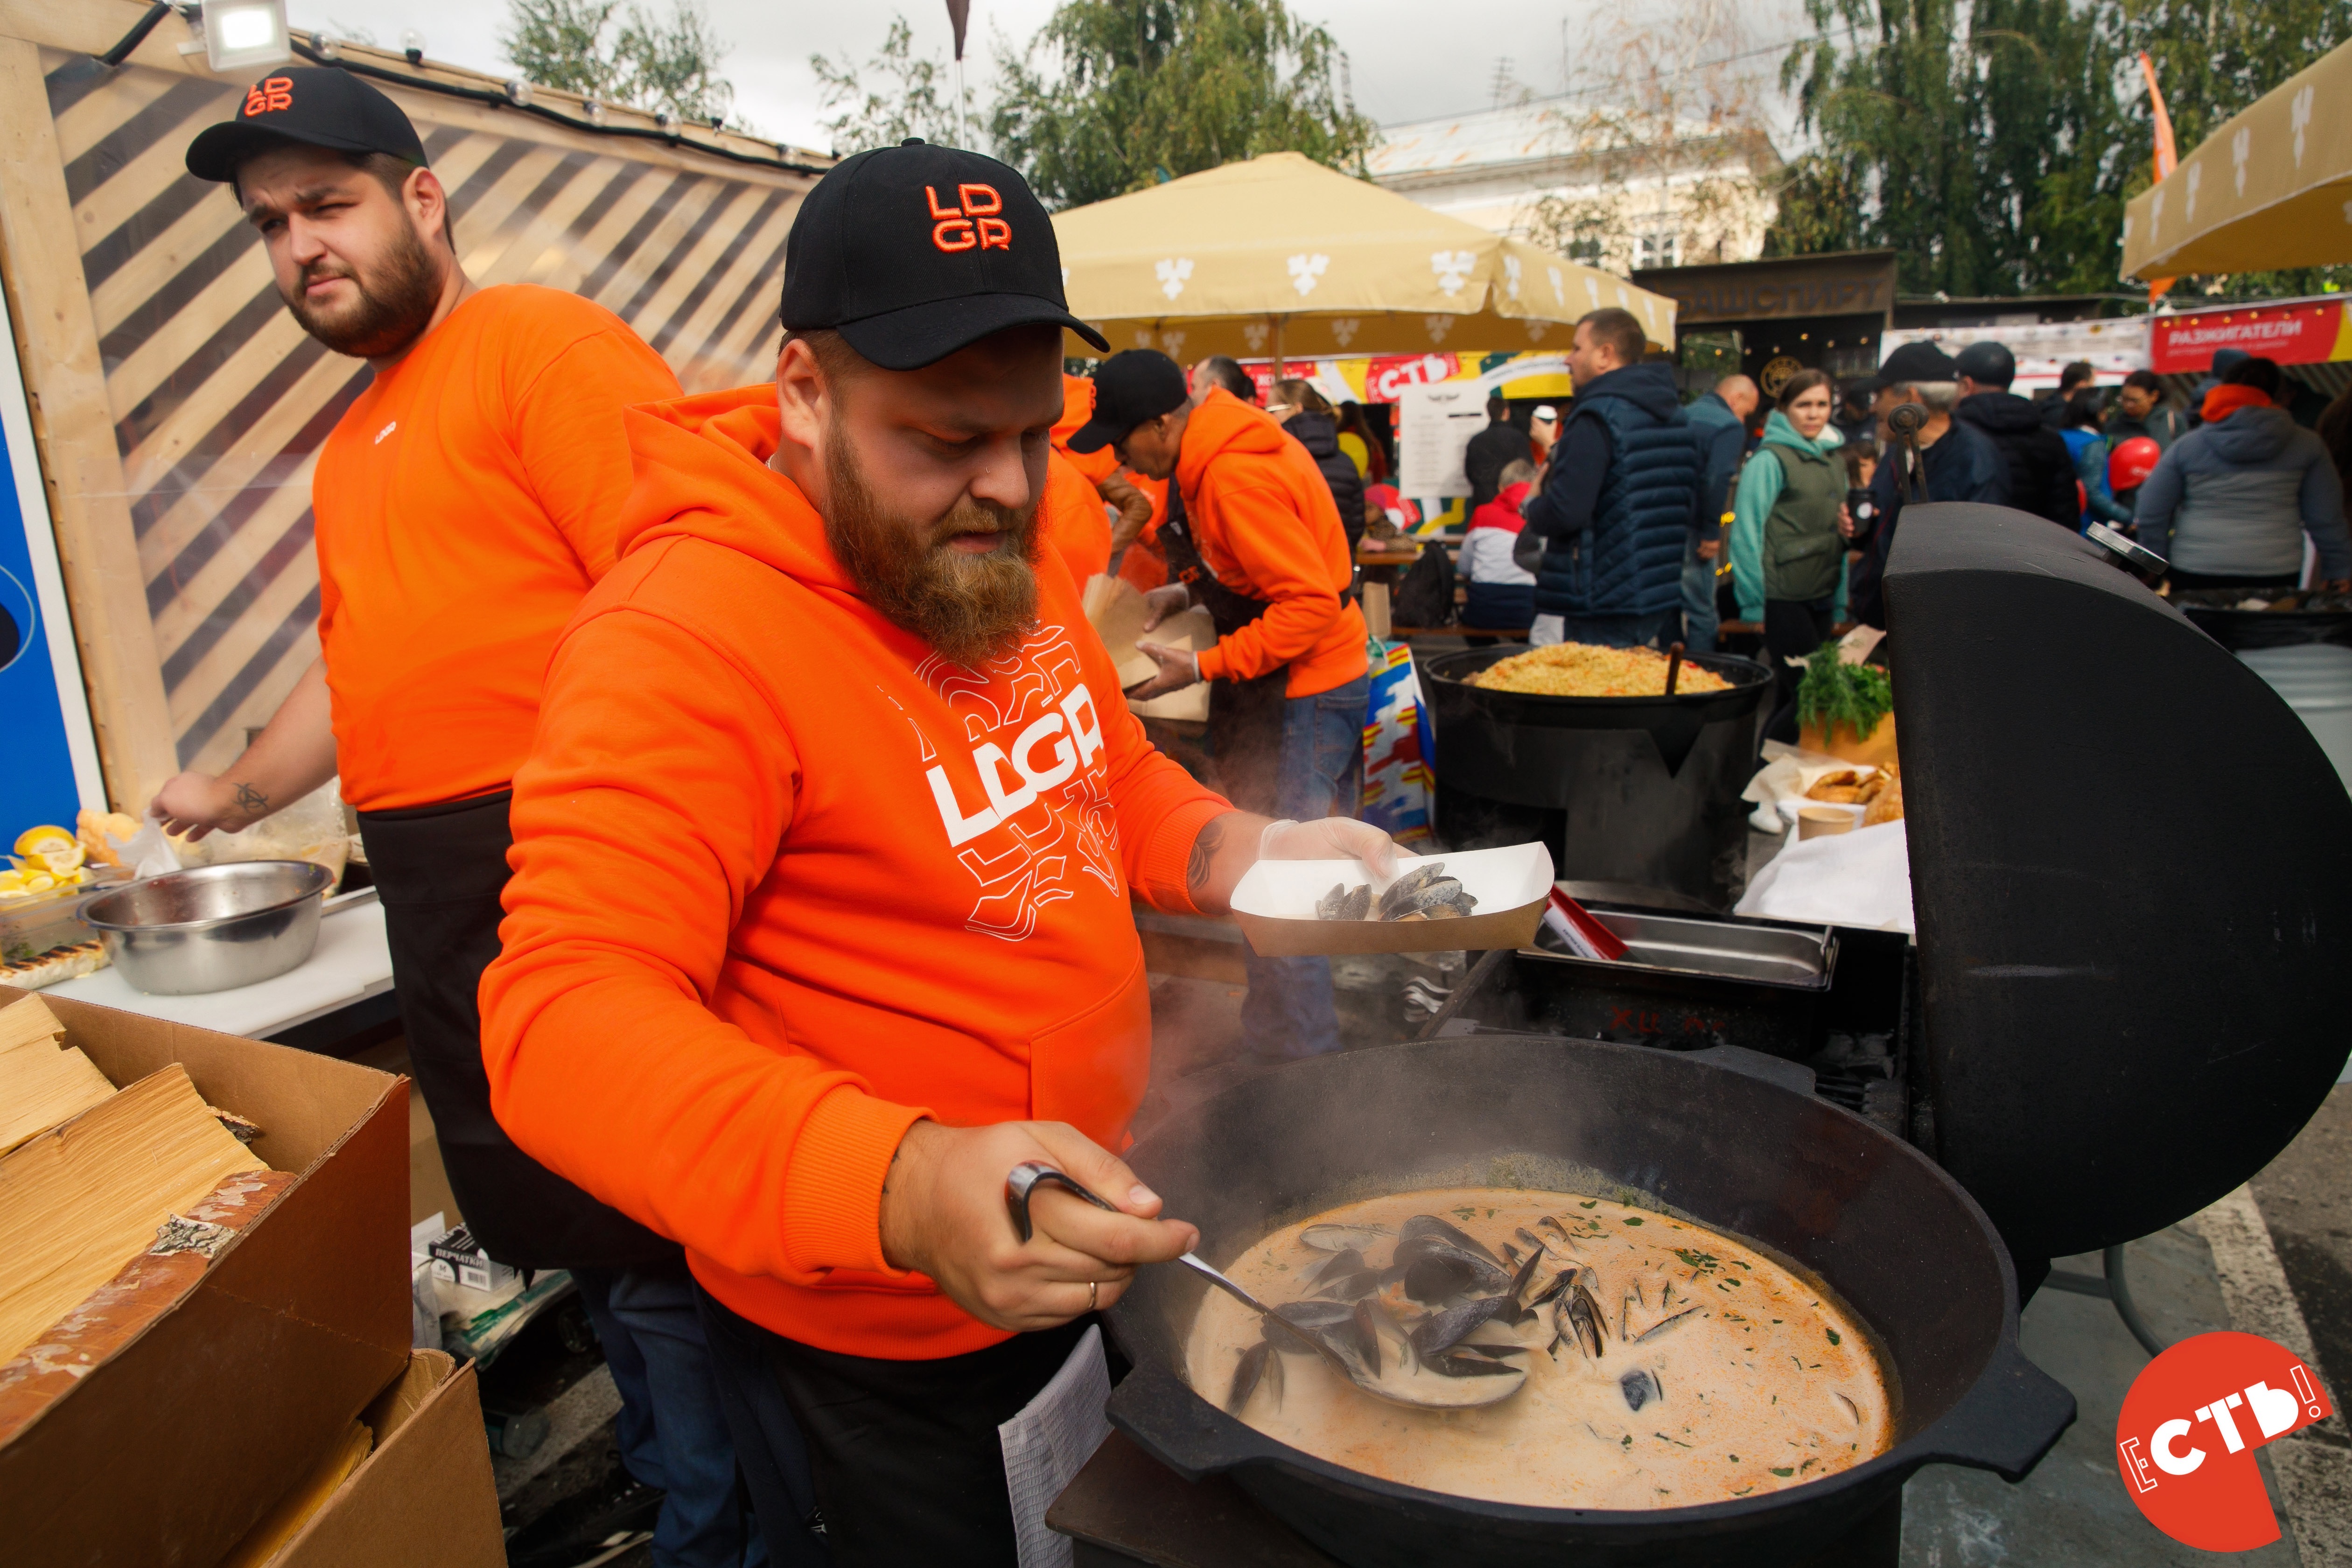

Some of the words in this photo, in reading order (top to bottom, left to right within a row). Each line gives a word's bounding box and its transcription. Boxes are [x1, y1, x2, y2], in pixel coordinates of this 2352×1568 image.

[244, 92, 293, 117] GR
[248, 77, 294, 101] LD
[925, 183, 1002, 220] LD
[932, 218, 1012, 253] GR
[1670, 278, 1884, 317] БАШСПИРТ
[2167, 318, 2303, 347] РАЗЖИГАТЕЛИ
